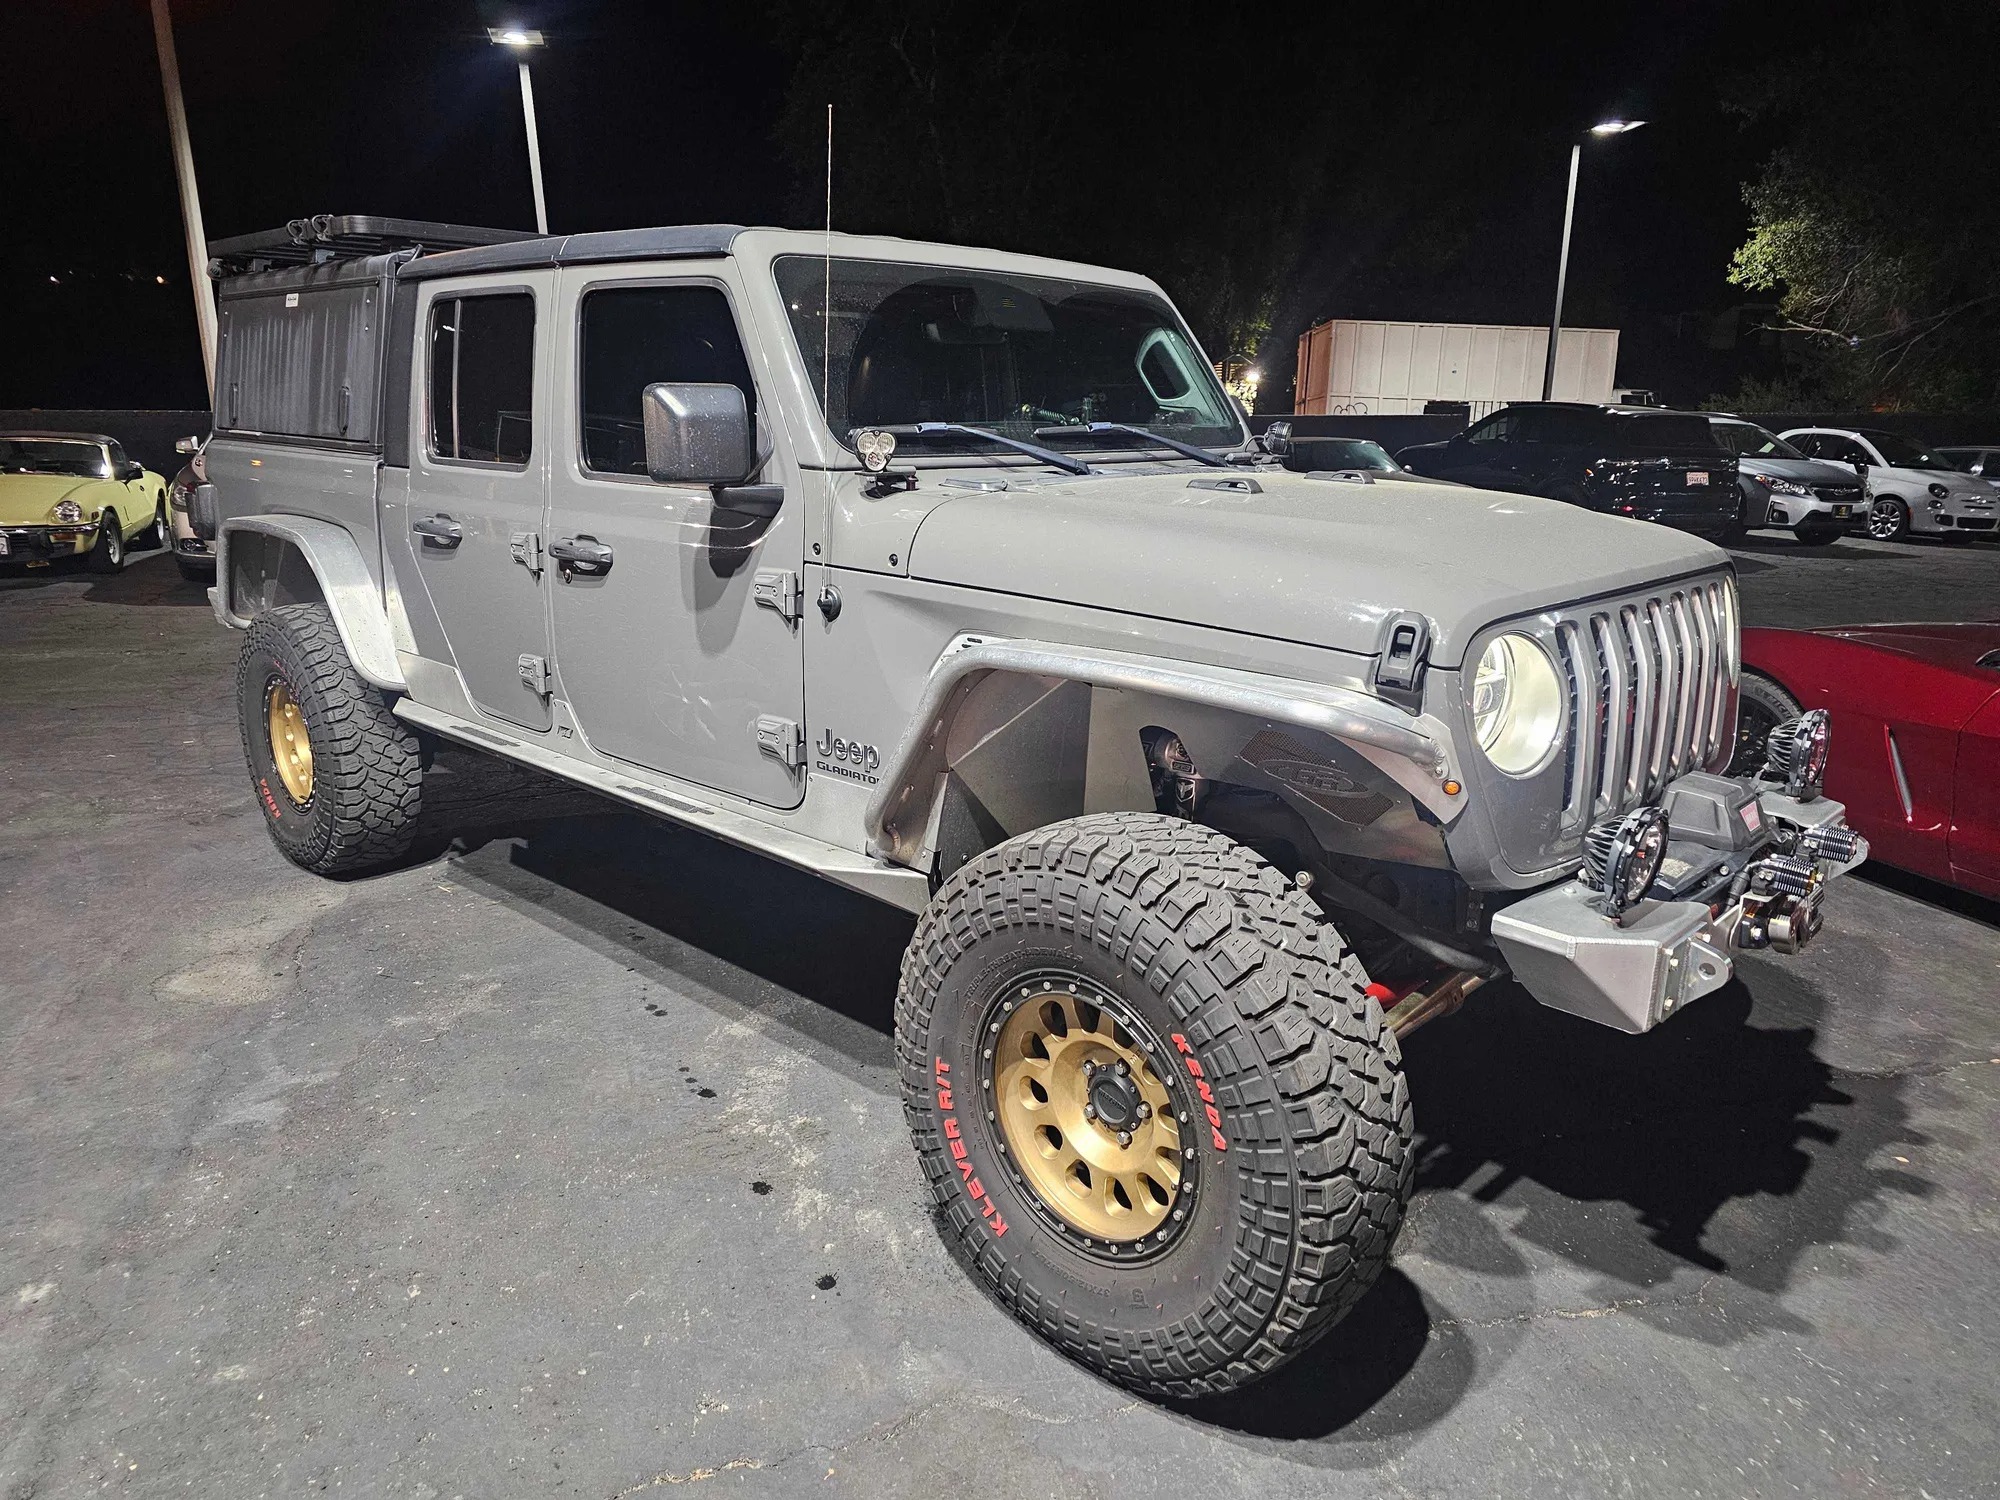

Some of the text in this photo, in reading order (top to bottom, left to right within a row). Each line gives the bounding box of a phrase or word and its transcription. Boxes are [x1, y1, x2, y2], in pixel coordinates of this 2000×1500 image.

[816, 728, 880, 773] Jeep
[816, 760, 880, 785] GLADIATO
[260, 778, 282, 819] KENDA
[935, 1056, 954, 1110] R/T
[1171, 1033, 1227, 1150] KENDA
[944, 1117, 1009, 1237] KLEVER
